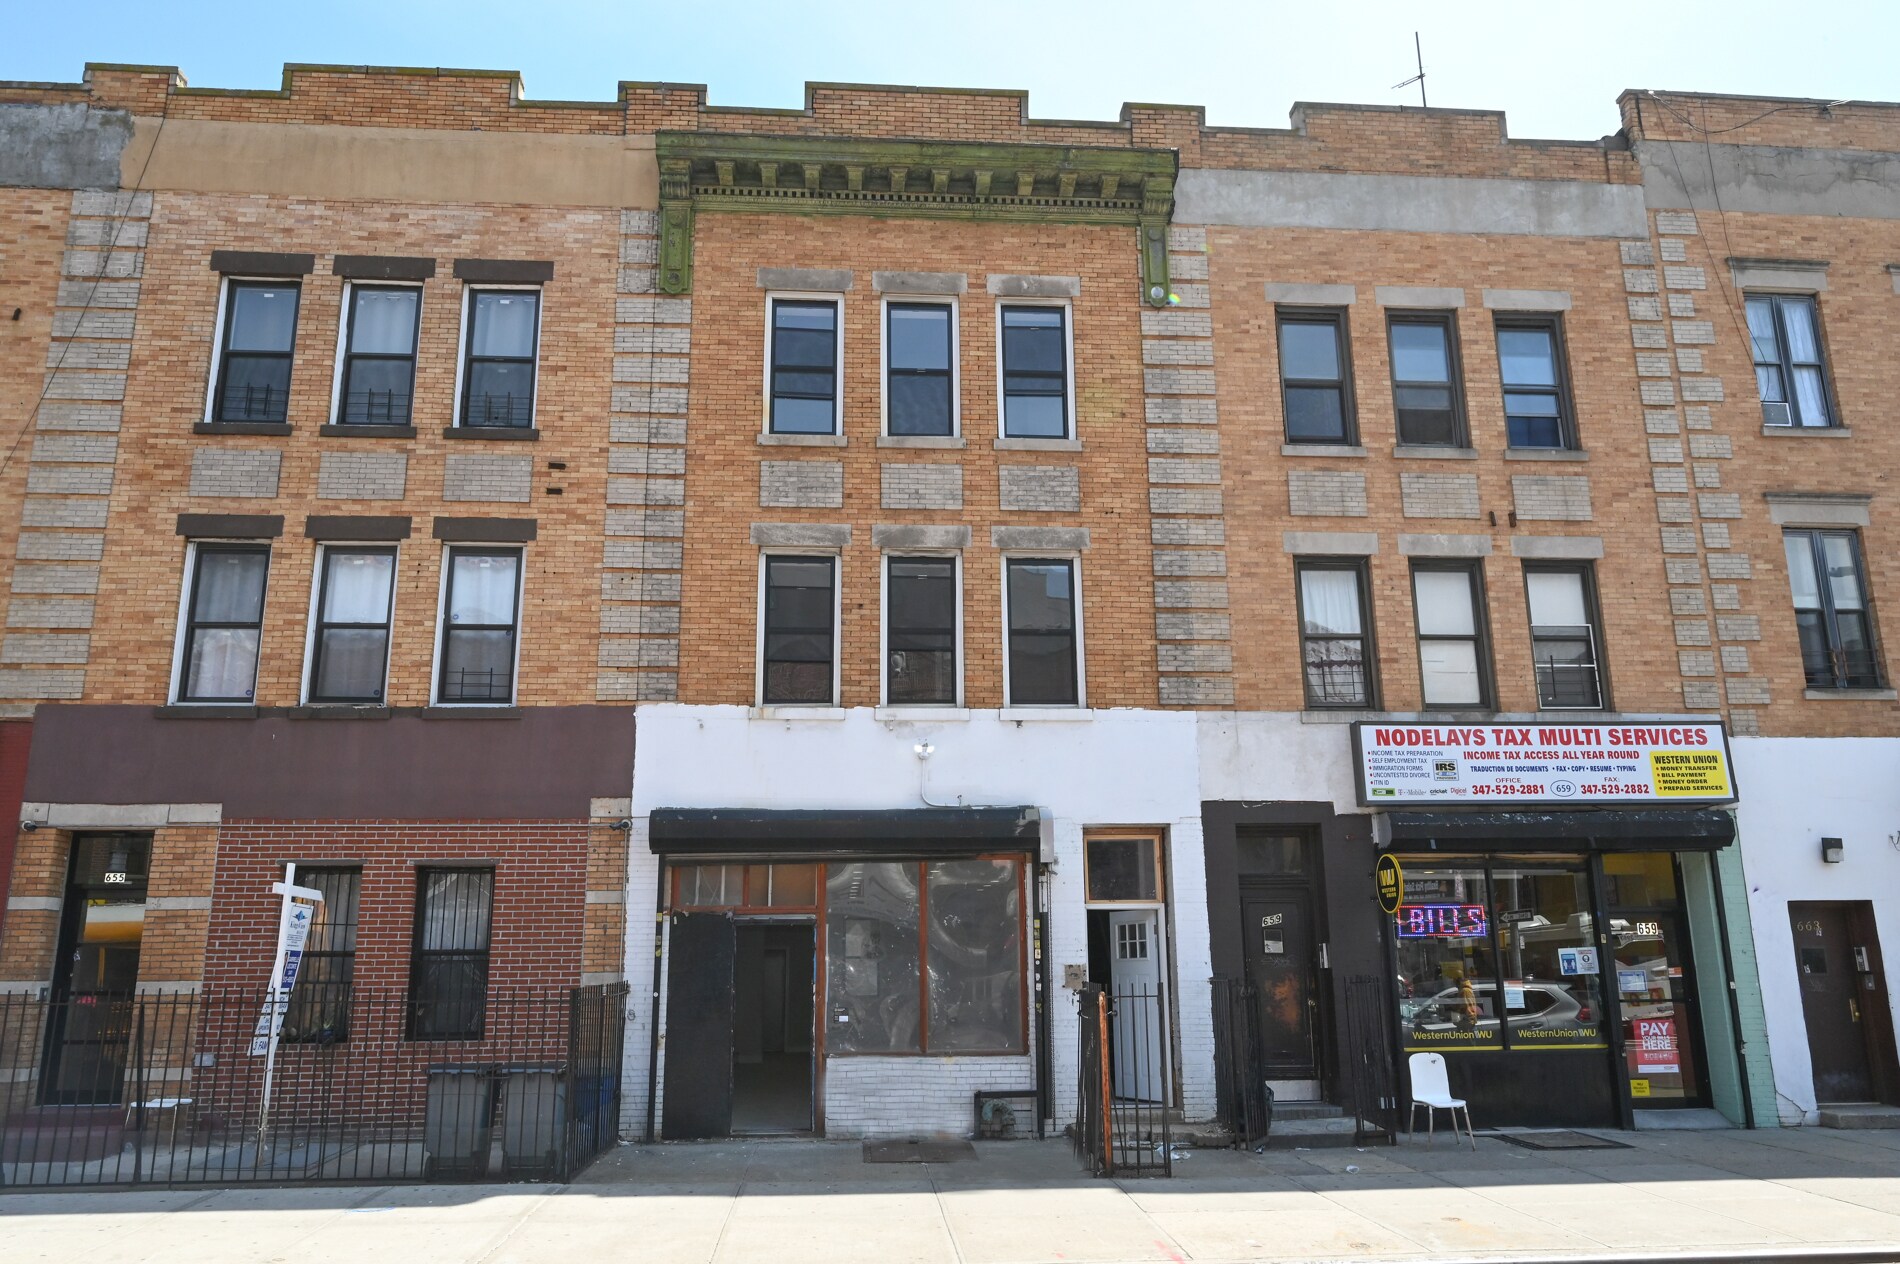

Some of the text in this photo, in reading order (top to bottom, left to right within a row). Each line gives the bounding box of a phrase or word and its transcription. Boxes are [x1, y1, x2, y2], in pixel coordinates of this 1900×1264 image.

[1375, 728, 1708, 746] NODELAYS TAX MULTI SERVICES
[1463, 750, 1640, 760] INCOME TAX ACCESS ALL YEAR ROUND
[1654, 755, 1718, 764] WESTERN UNION
[1435, 763, 1456, 772] IRS
[1472, 784, 1544, 795] 347-529-2881
[1556, 784, 1571, 793] 659
[1580, 784, 1650, 794] 347-529-2882
[106, 874, 124, 882] 655
[1380, 868, 1395, 886] WU
[1263, 915, 1281, 925] 659
[1410, 908, 1482, 933] BILLS
[1638, 924, 1658, 934] 659
[1797, 920, 1820, 931] 663
[1518, 1028, 1597, 1038] WesternUnion WU
[1640, 1022, 1669, 1035] PAY
[1412, 1030, 1493, 1040] WesternUnion WU
[1642, 1040, 1672, 1050] HERE
